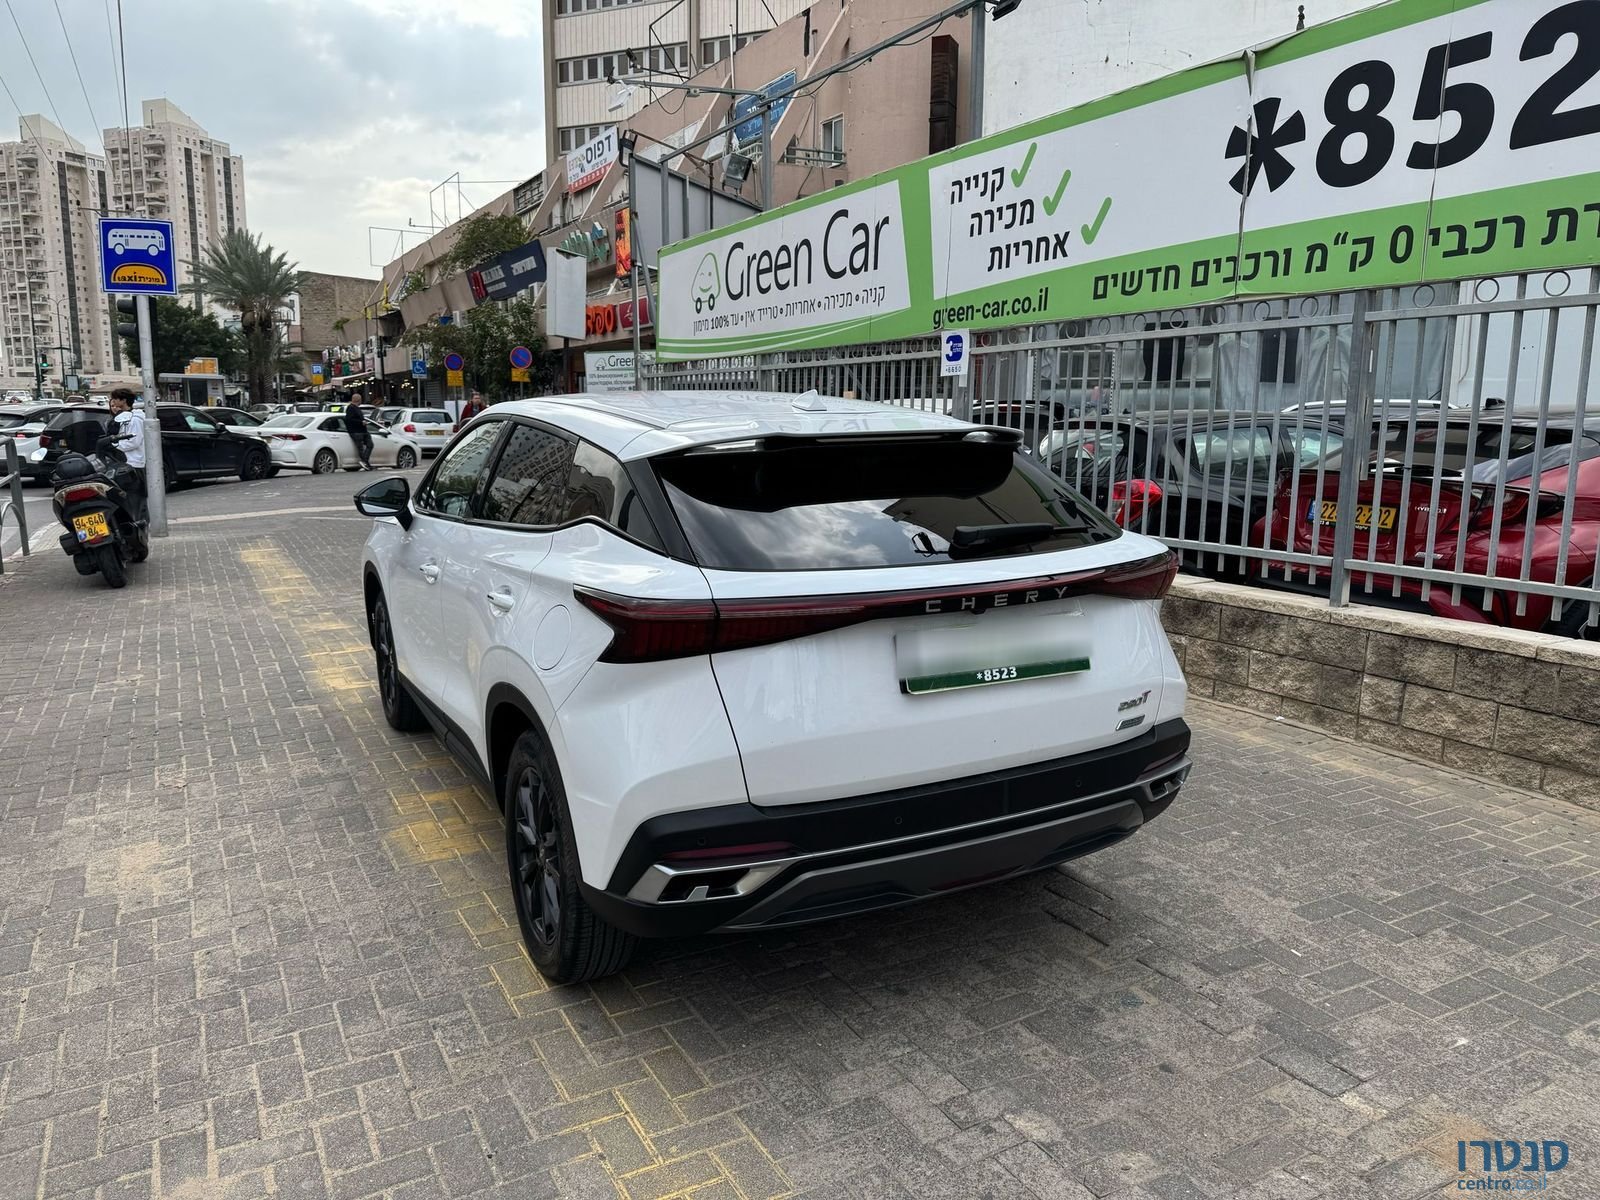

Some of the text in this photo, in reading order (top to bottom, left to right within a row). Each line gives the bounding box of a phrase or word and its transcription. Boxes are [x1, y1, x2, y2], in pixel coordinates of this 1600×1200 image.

[585, 134, 611, 164] דפוס
[950, 166, 1005, 204] קנייה
[970, 199, 1035, 237] מכירה
[725, 208, 890, 301] Green Car
[988, 231, 1070, 272] אחריות
[1389, 225, 1414, 264] 0
[1429, 215, 1525, 259] רכבי
[117, 271, 160, 283] taxi מונית
[1092, 264, 1181, 300] חדשים
[1190, 248, 1292, 288] ורכבים
[785, 298, 816, 317] אחריות
[823, 291, 853, 311] מכירה
[862, 286, 886, 307] קניה
[933, 287, 1049, 330] green-car.co.il
[711, 315, 729, 330] 100%
[925, 586, 1068, 613] CHERY
